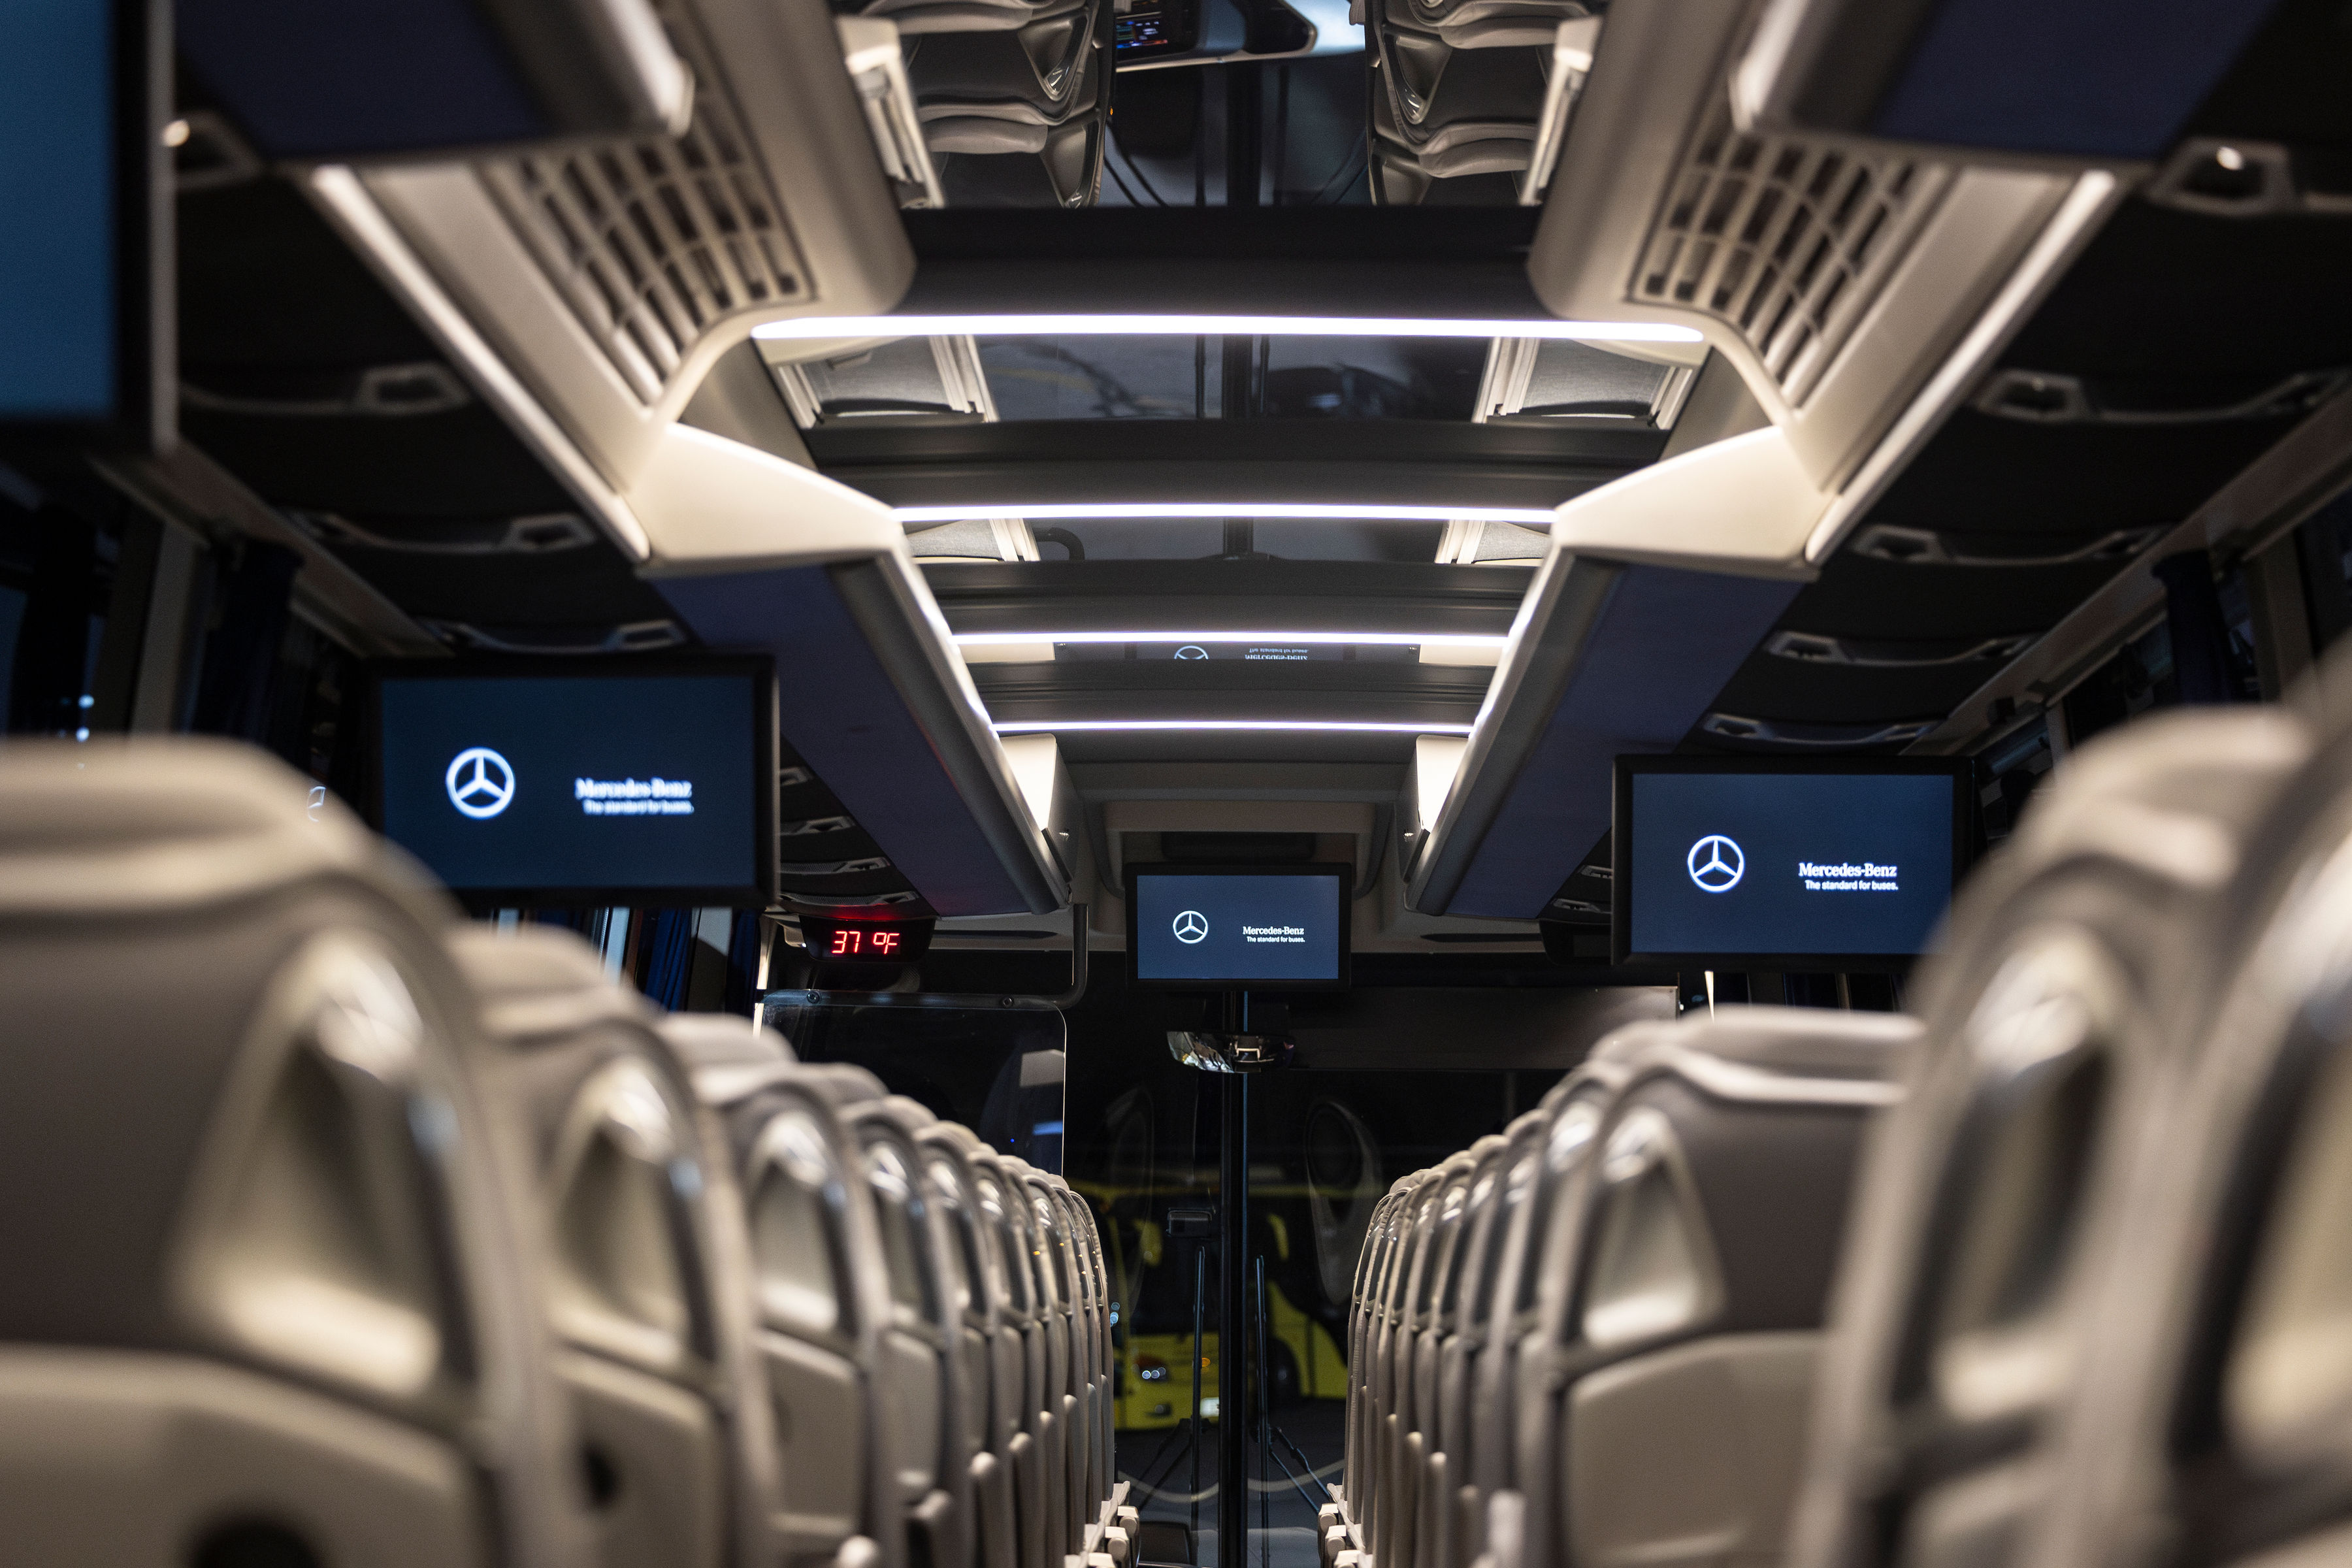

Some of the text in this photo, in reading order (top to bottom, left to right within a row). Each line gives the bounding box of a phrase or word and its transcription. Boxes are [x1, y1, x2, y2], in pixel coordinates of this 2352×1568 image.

[1798, 862, 1897, 877] Mercedes-Benz
[1805, 879, 1899, 890] The standard for buses.
[1243, 926, 1304, 935] Mercedes-Benz
[832, 931, 860, 953] 37
